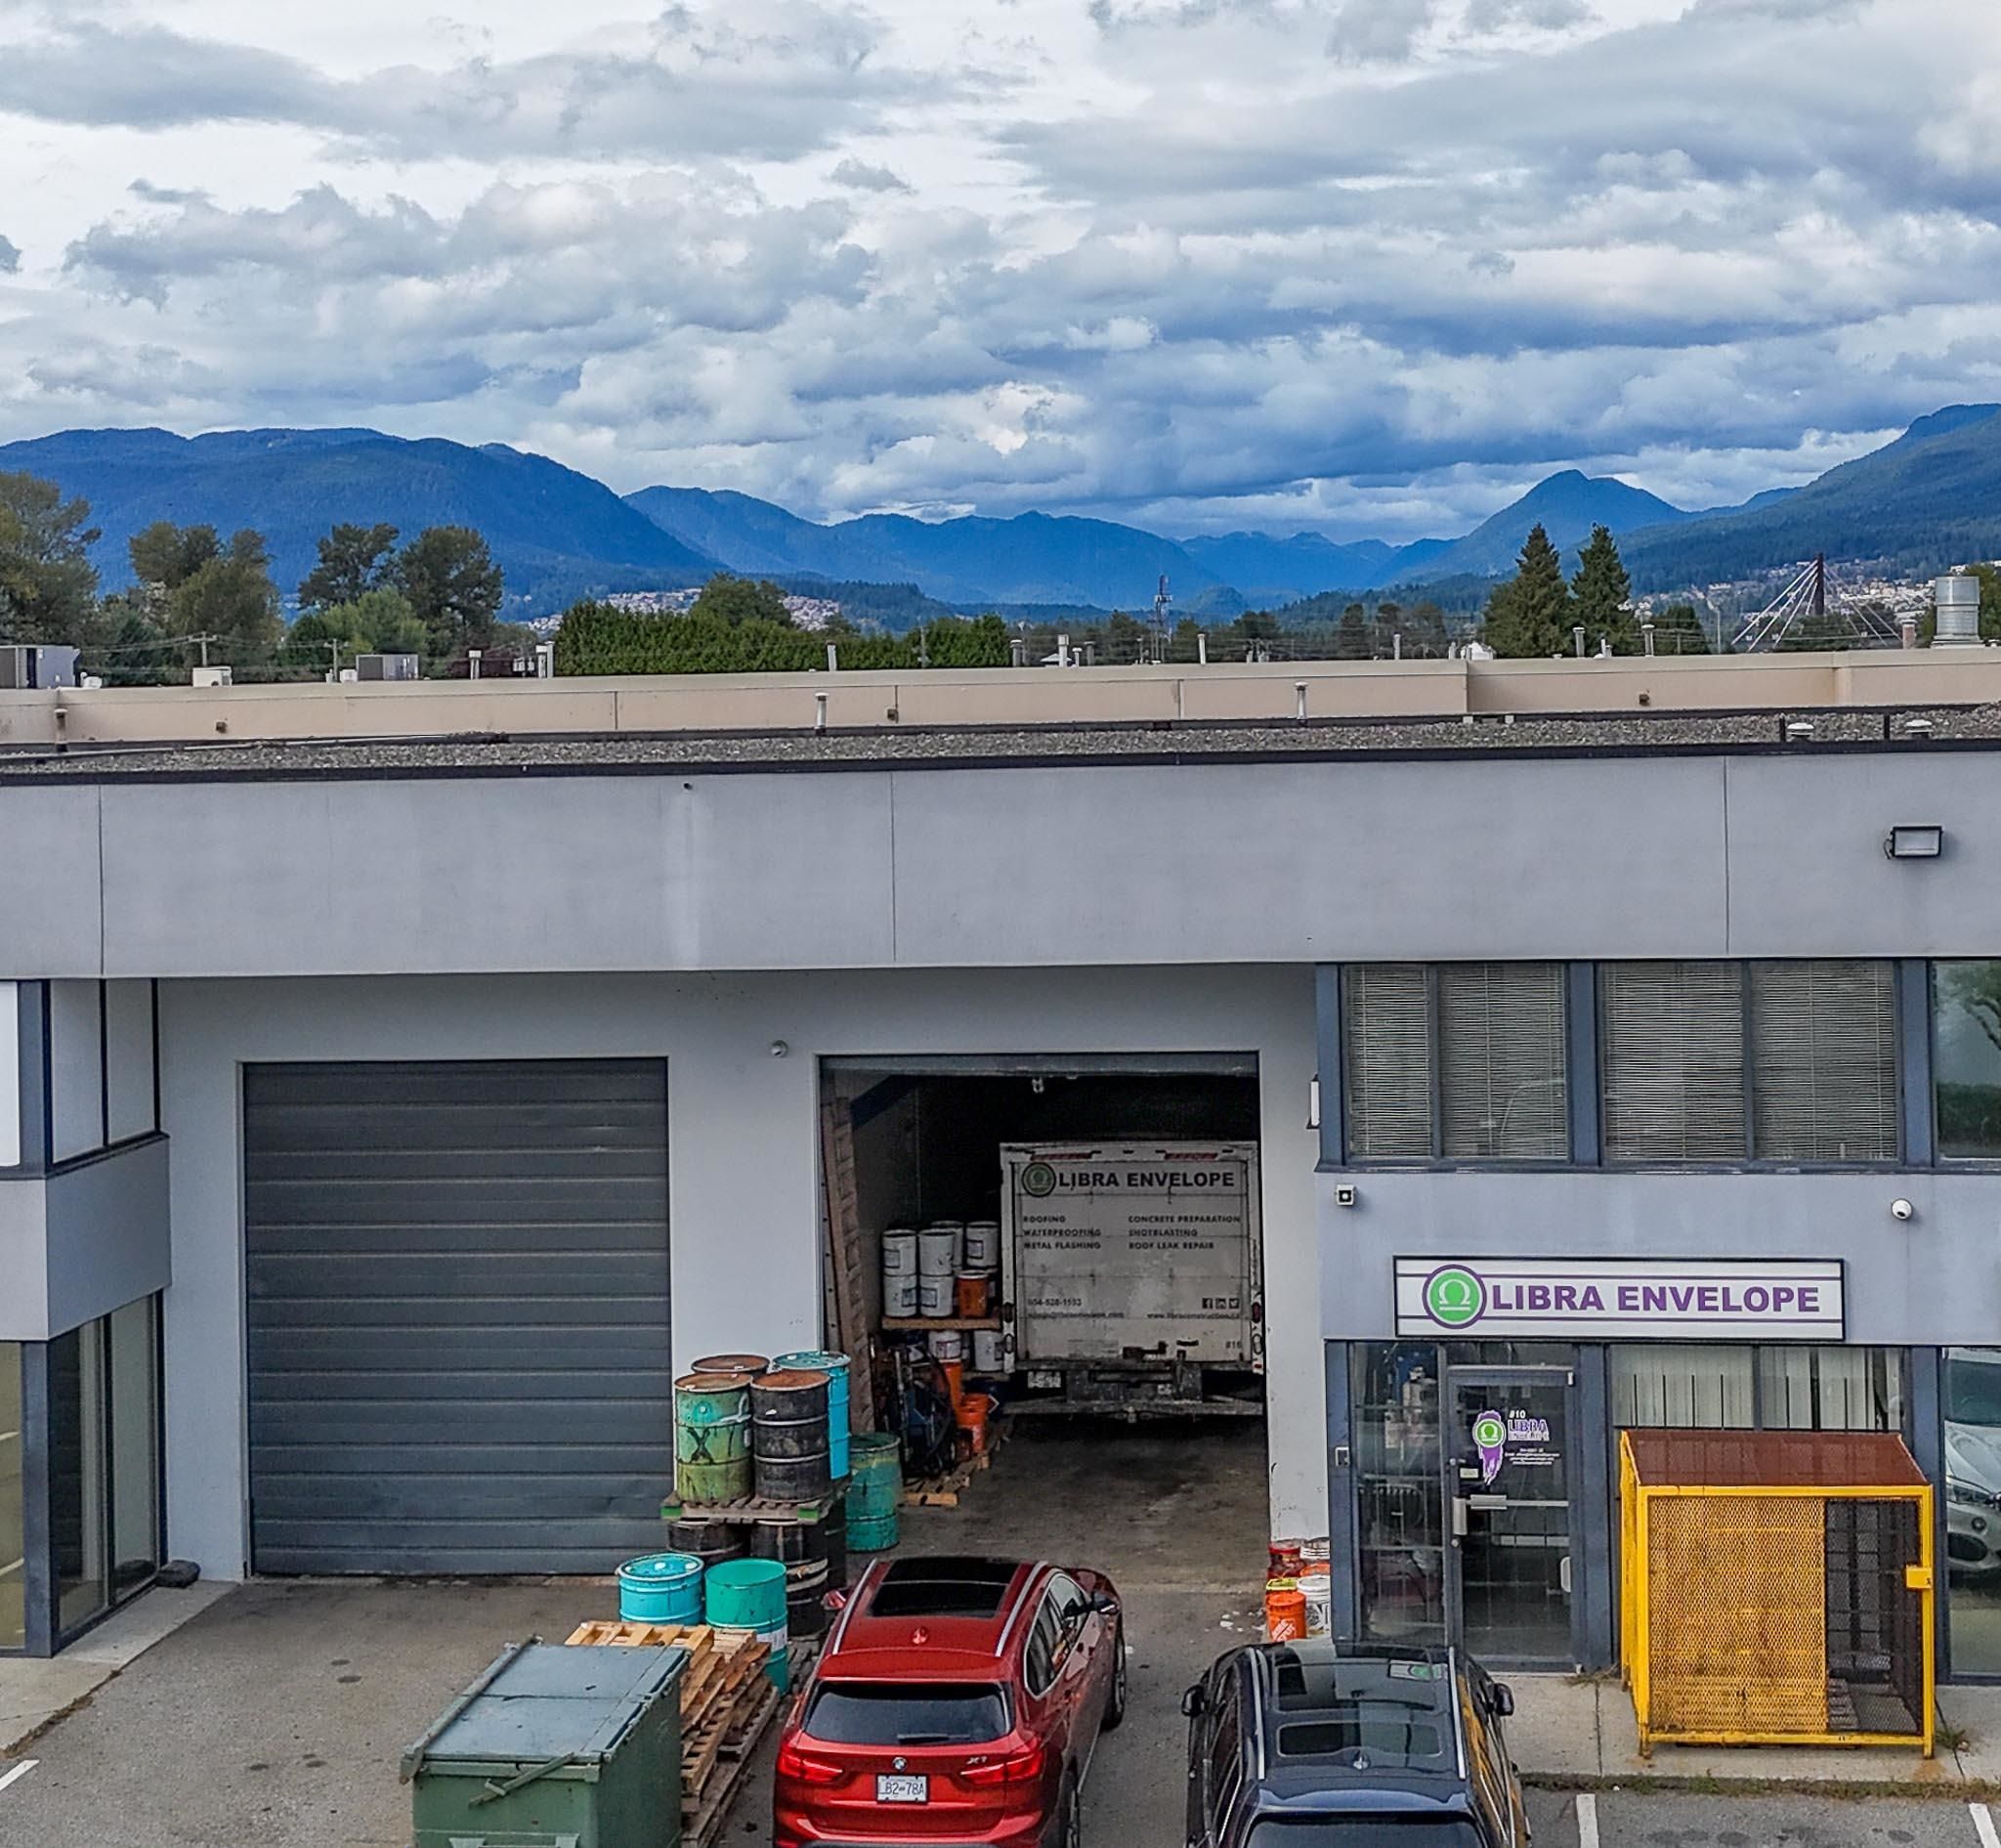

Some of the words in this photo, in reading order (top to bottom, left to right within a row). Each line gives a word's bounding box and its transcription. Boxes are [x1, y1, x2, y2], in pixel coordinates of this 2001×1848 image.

[1058, 1172, 1119, 1187] LIBRA
[1127, 1172, 1235, 1187] ENVELOPE
[1023, 1215, 1066, 1224] ROOFING
[1128, 1215, 1174, 1224] CONCRETE
[1177, 1215, 1241, 1224] PREPARATION
[1023, 1228, 1102, 1237] WATERPROOFING
[1023, 1241, 1052, 1250] METAL
[1055, 1241, 1101, 1250] FLASHING
[1128, 1241, 1154, 1250] ROOF
[1157, 1241, 1178, 1250] LEAK
[1182, 1241, 1214, 1250] REPAIR
[1492, 1284, 1605, 1311] LIBRA
[1617, 1285, 1820, 1313] ENVELOPE
[1508, 1419, 1548, 1432] LIBRA
